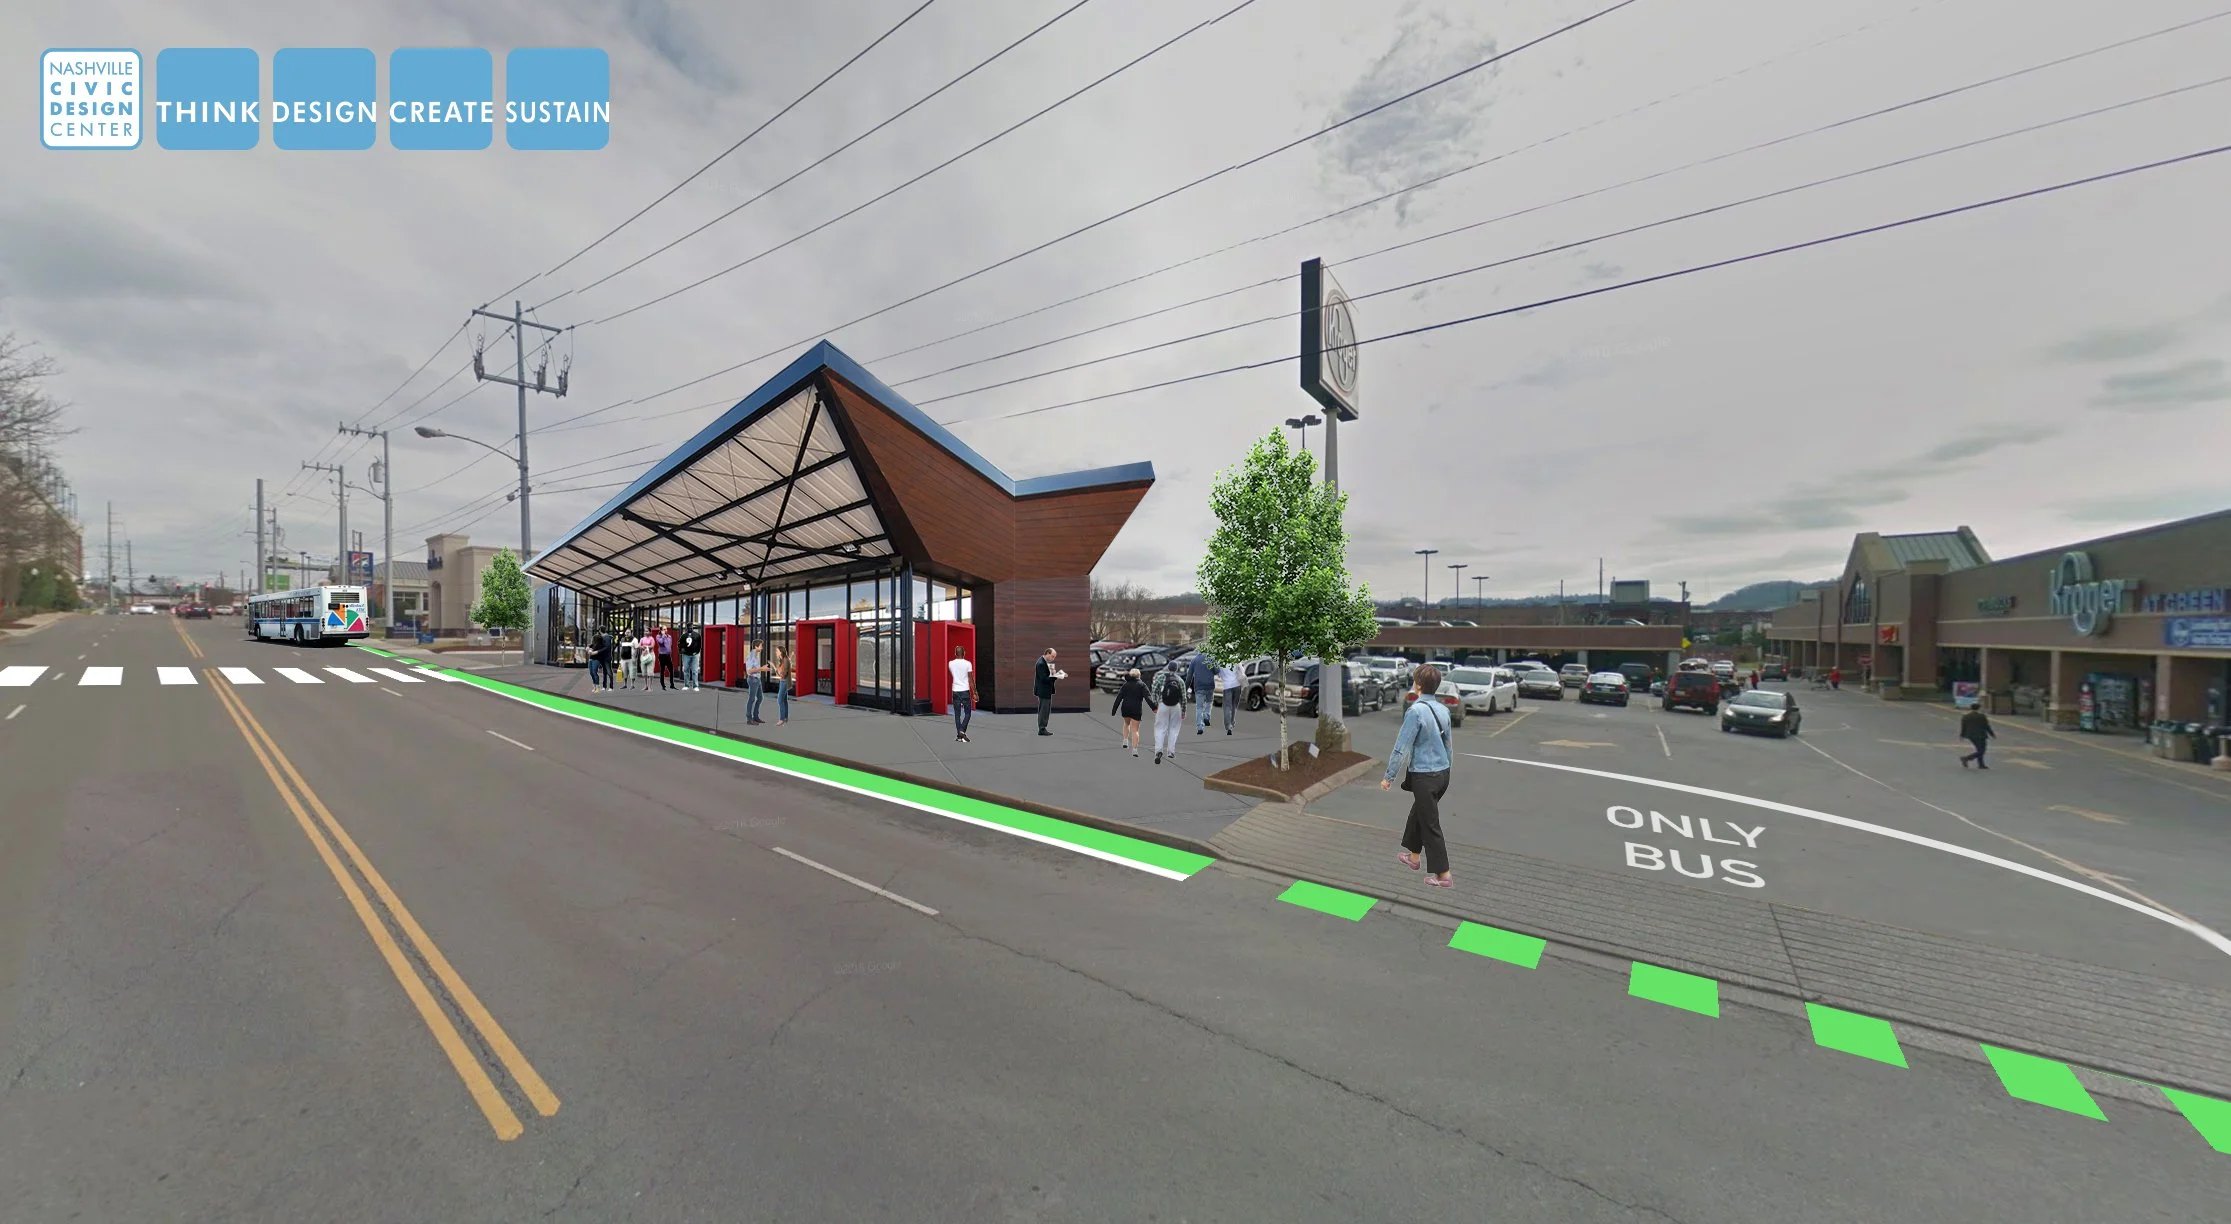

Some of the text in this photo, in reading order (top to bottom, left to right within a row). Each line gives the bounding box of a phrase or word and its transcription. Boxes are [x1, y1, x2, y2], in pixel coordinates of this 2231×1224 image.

[2049, 552, 2127, 636] Kroger
[2165, 587, 2225, 613] GREEN
[685, 637, 693, 648] 9
[1606, 805, 1766, 848] ONLY
[1624, 841, 1766, 888] BUS
